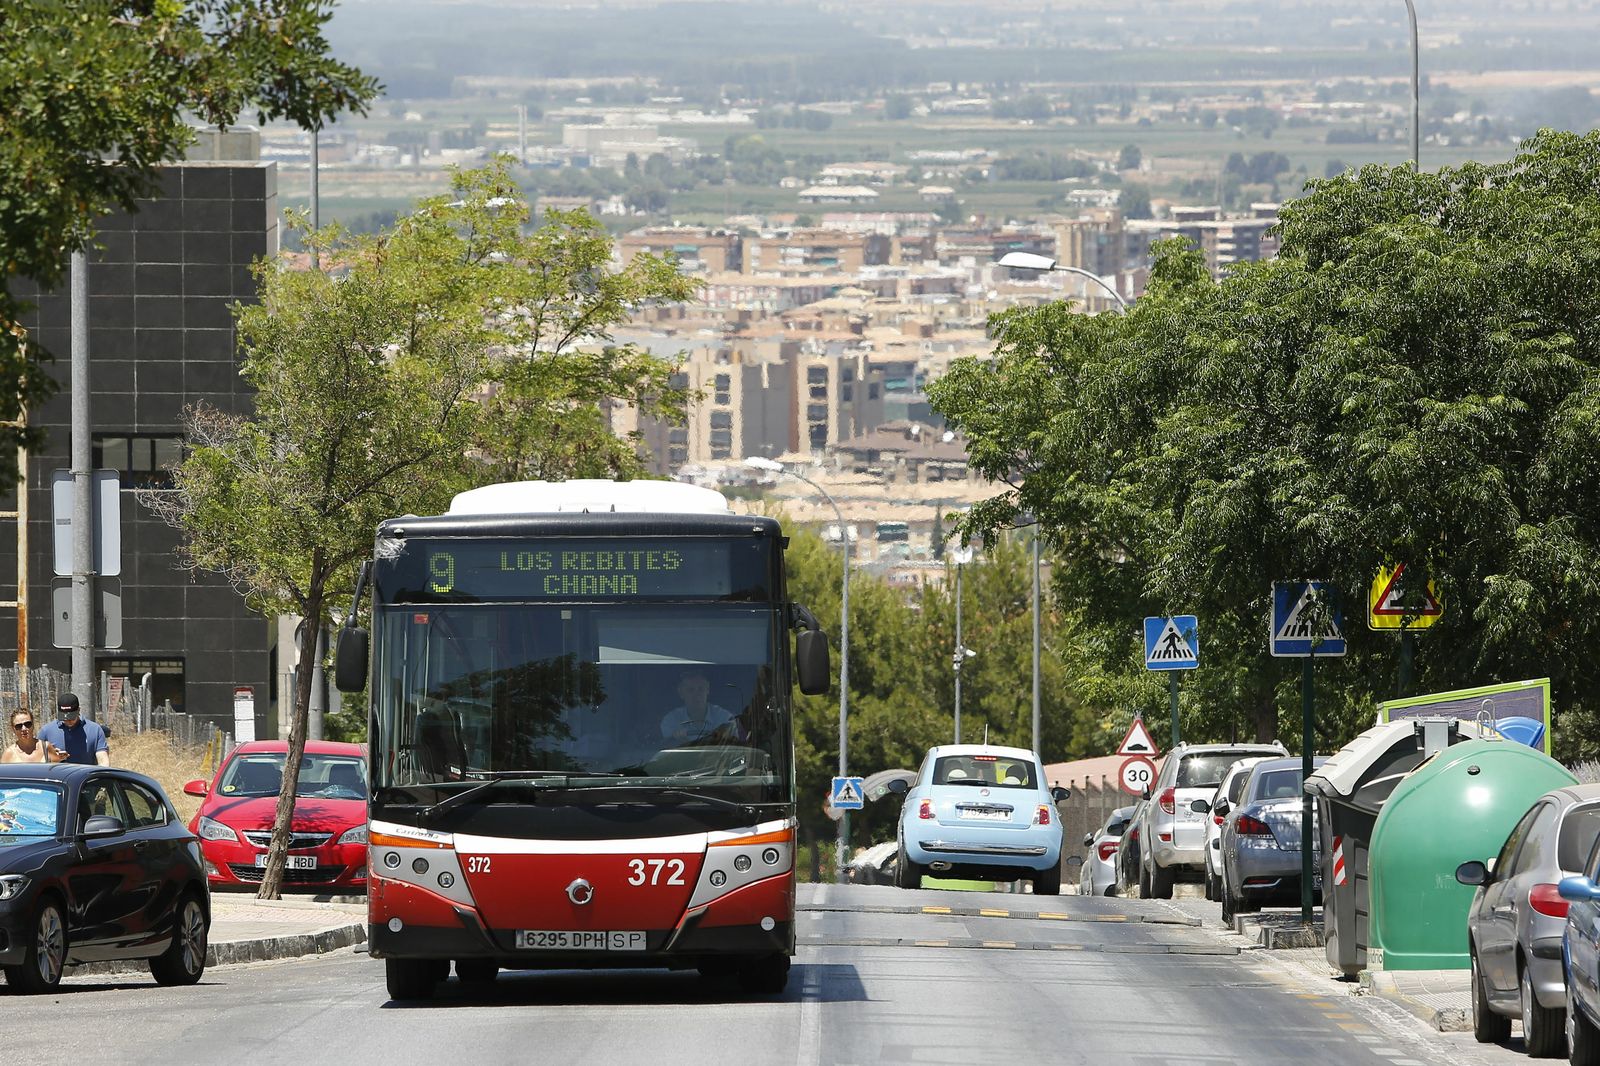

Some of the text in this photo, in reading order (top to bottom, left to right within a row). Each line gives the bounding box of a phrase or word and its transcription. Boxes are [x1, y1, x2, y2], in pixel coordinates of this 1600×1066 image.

[501, 550, 680, 571] LOS REBITES
[429, 552, 454, 593] 9
[544, 575, 637, 594] CHANA
[1128, 770, 1149, 782] 30
[468, 857, 491, 873] 372
[628, 859, 685, 886] 372
[526, 932, 604, 948] 6295 DPH
